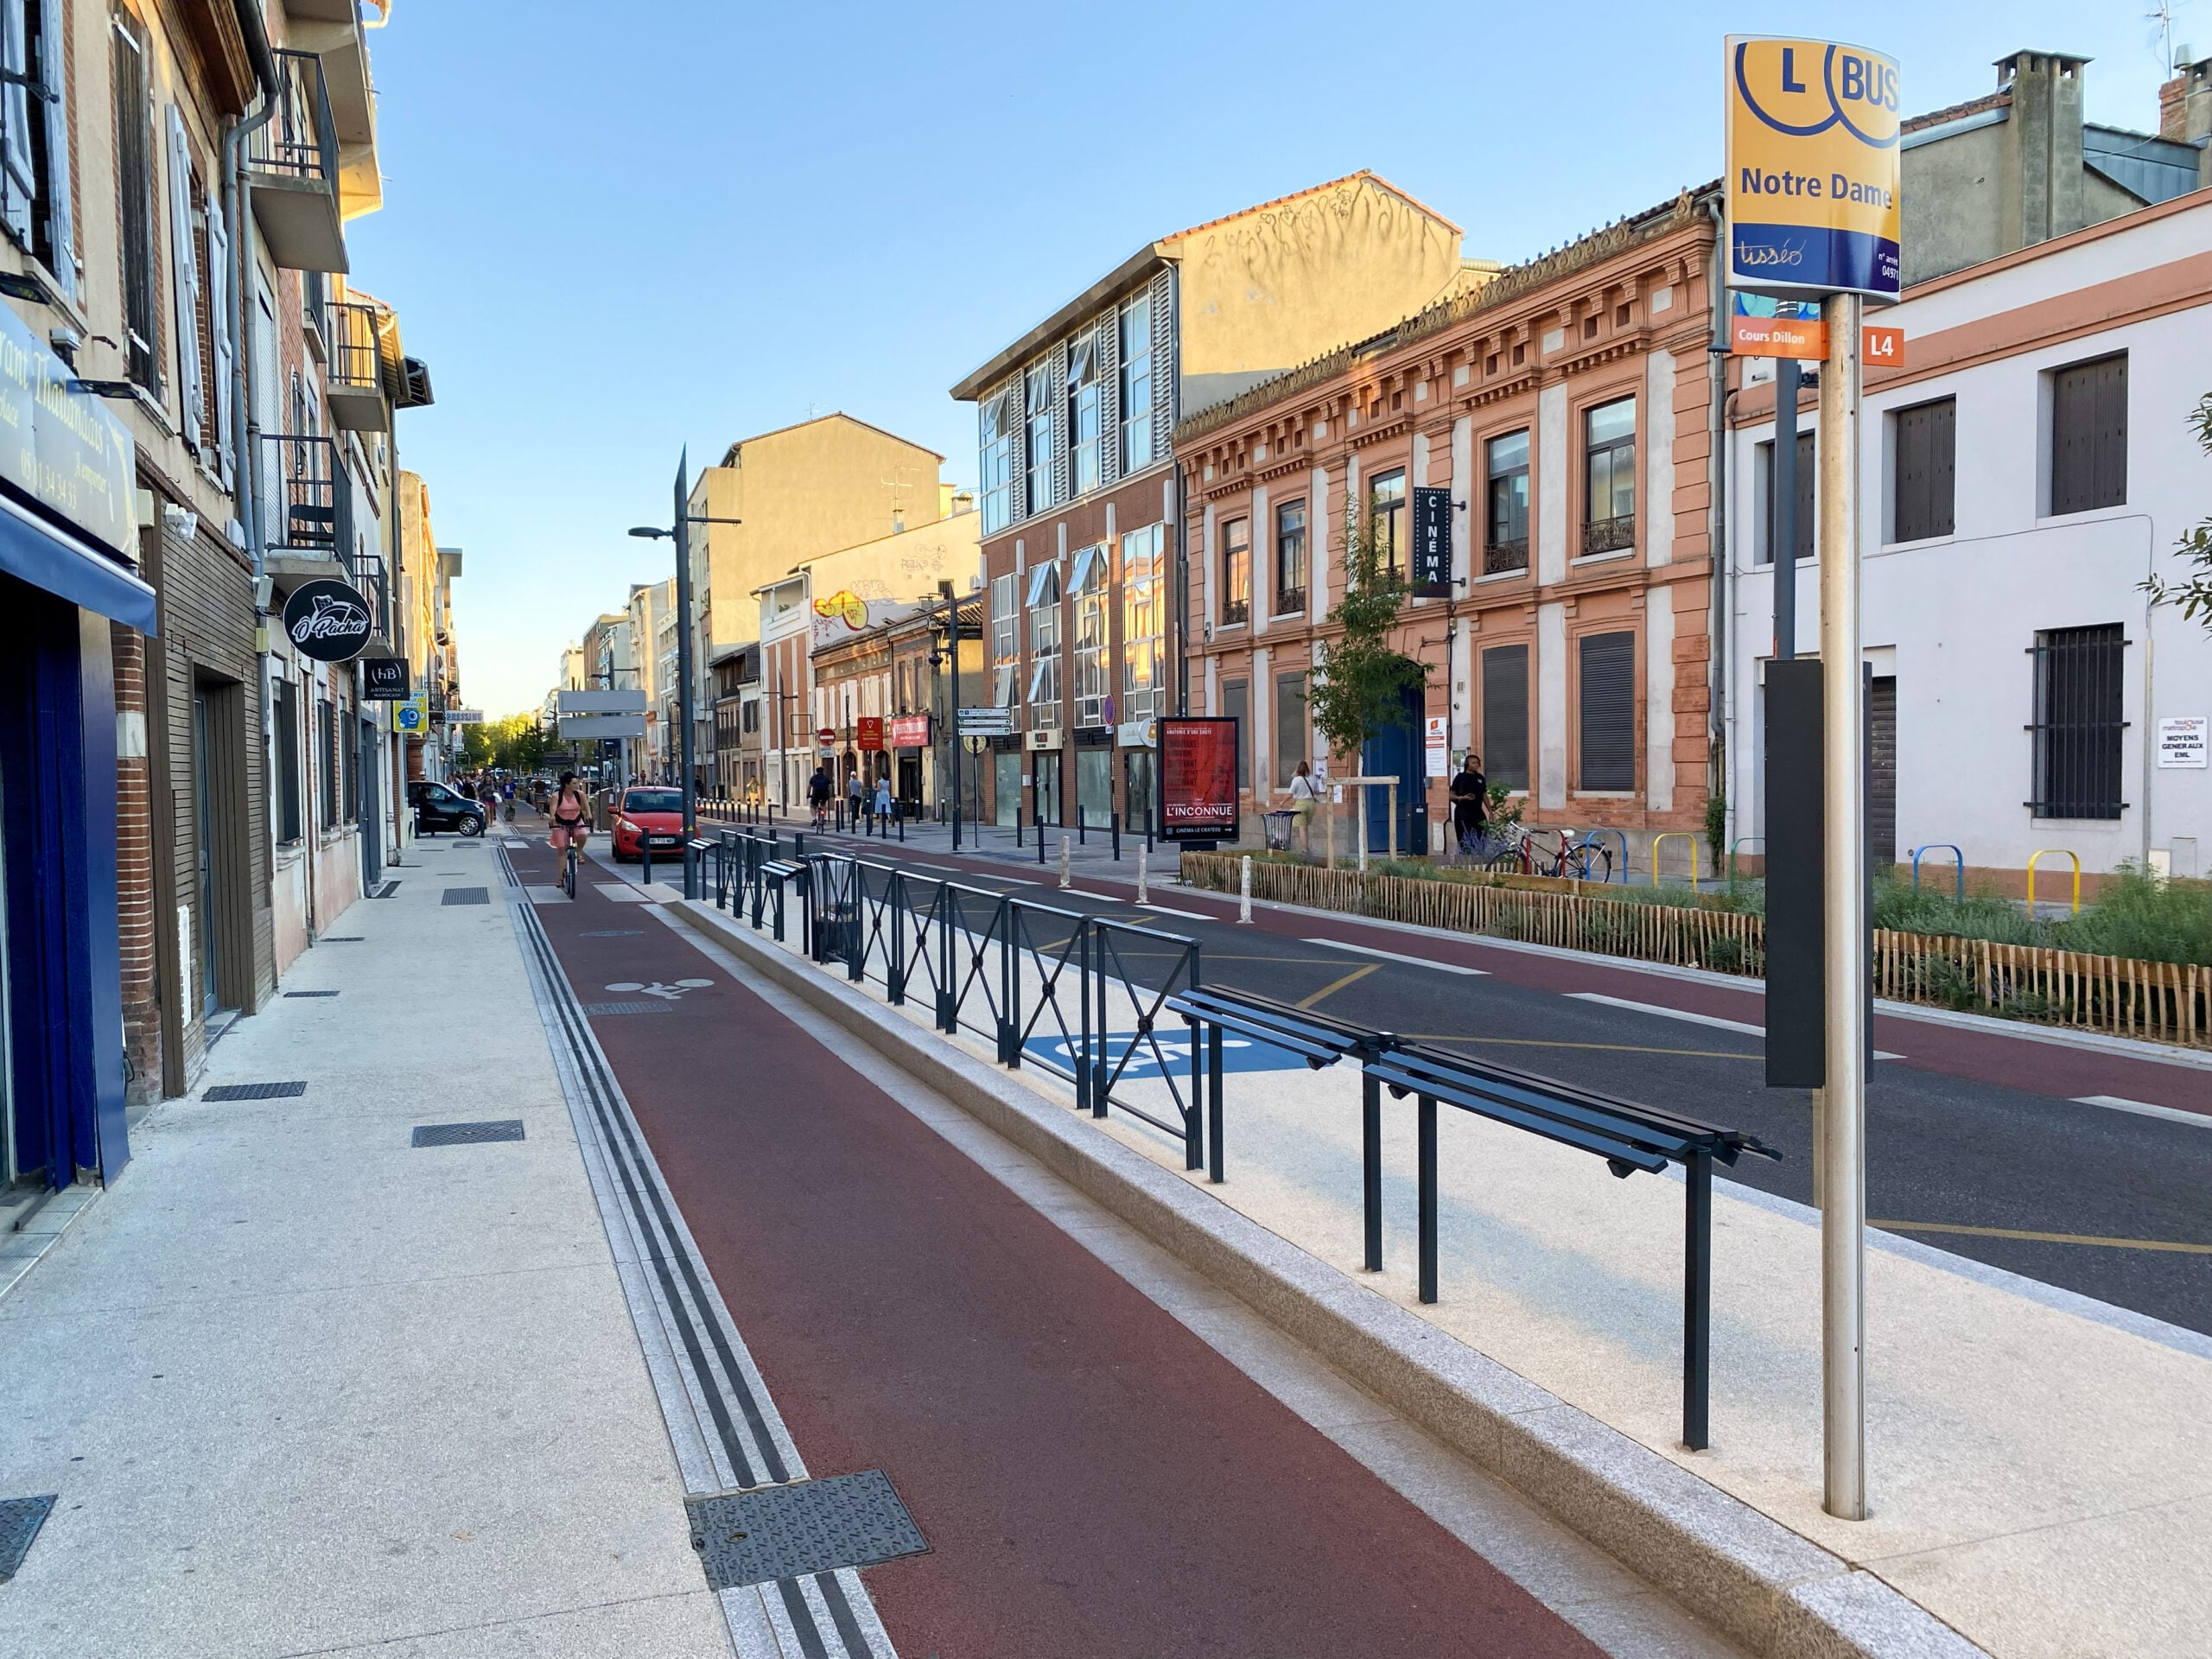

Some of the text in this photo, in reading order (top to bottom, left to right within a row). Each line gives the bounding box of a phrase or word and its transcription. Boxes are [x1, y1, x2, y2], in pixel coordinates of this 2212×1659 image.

[1783, 48, 1898, 112] L BUS
[1742, 168, 1892, 210] Notre Dame
[1738, 329, 1805, 345] Cours Dillon
[1871, 334, 1893, 356] L4
[1427, 495, 1439, 582] CINÉMA
[1166, 806, 1233, 817] L'INCONNUE
